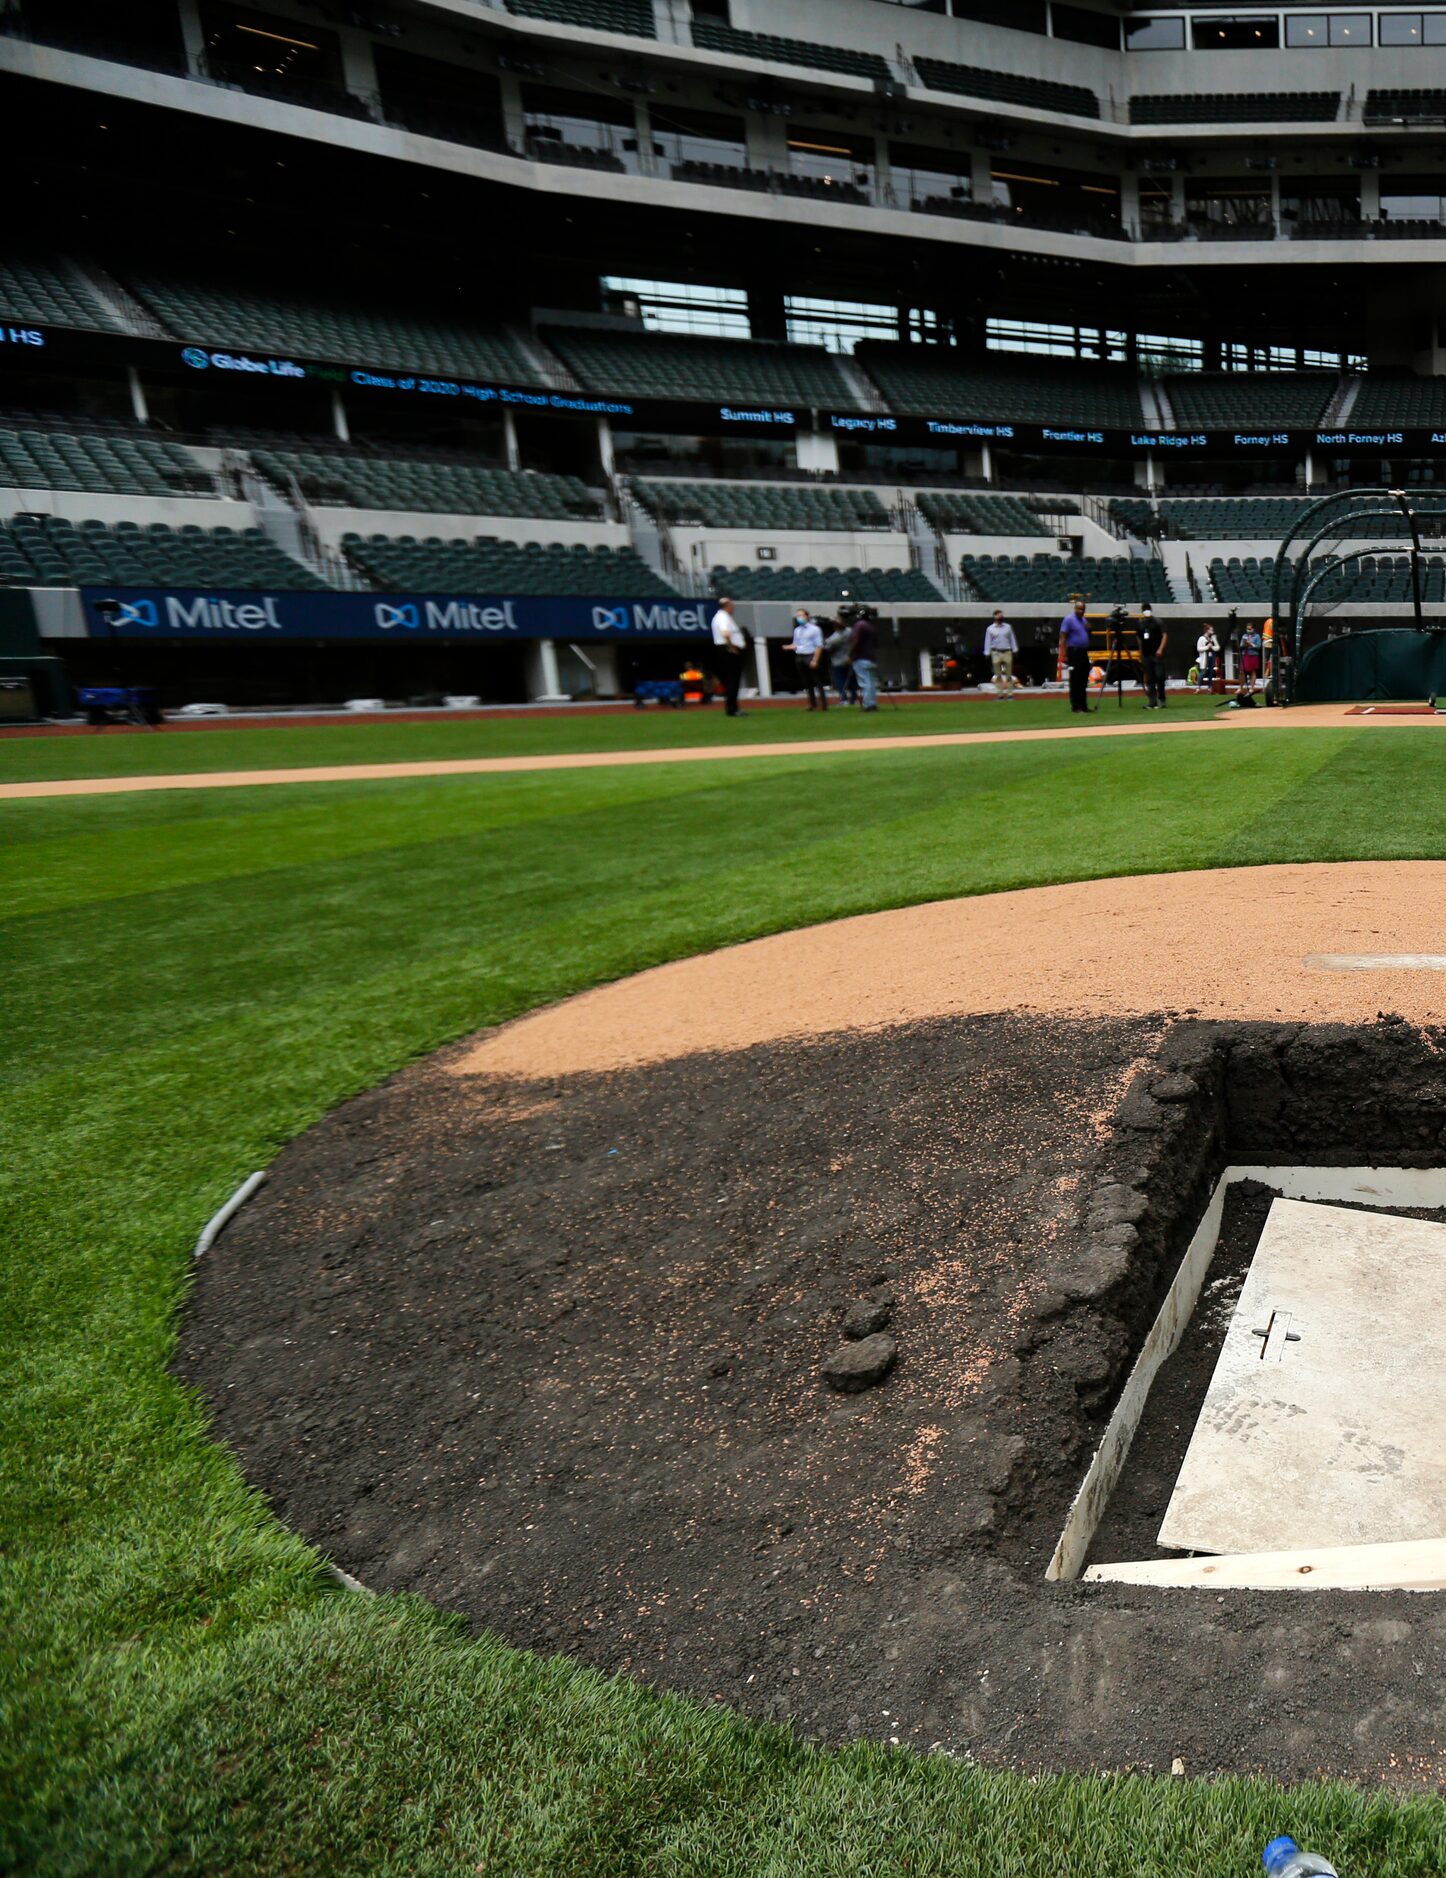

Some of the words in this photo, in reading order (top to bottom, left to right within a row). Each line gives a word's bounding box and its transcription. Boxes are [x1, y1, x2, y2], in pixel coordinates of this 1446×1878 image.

[9, 327, 45, 346] HS
[211, 353, 269, 373] Globe
[269, 359, 305, 378] Life
[351, 371, 396, 388] Class
[397, 377, 415, 389] of
[418, 379, 459, 395] 2020
[461, 385, 497, 401] High
[499, 389, 548, 405] School
[550, 395, 633, 415] Graduations
[720, 408, 772, 423] Summit
[774, 411, 795, 424] HS
[831, 416, 875, 431] Legacy
[877, 418, 897, 430] HS
[926, 421, 994, 436] Timberview
[996, 426, 1014, 437] HS
[1042, 429, 1086, 442] Frontier
[1087, 432, 1104, 443] HS
[1131, 435, 1157, 445] Lake
[1159, 435, 1189, 447] Ridge
[1191, 435, 1207, 445] HS
[1234, 435, 1271, 446] Forney
[1272, 434, 1289, 444] HS
[1316, 434, 1346, 443] North
[1349, 434, 1385, 445] Forney
[1387, 433, 1403, 443] HS
[165, 597, 282, 629] Mitel
[424, 600, 518, 630] Mitel
[633, 604, 708, 630] Mitel
